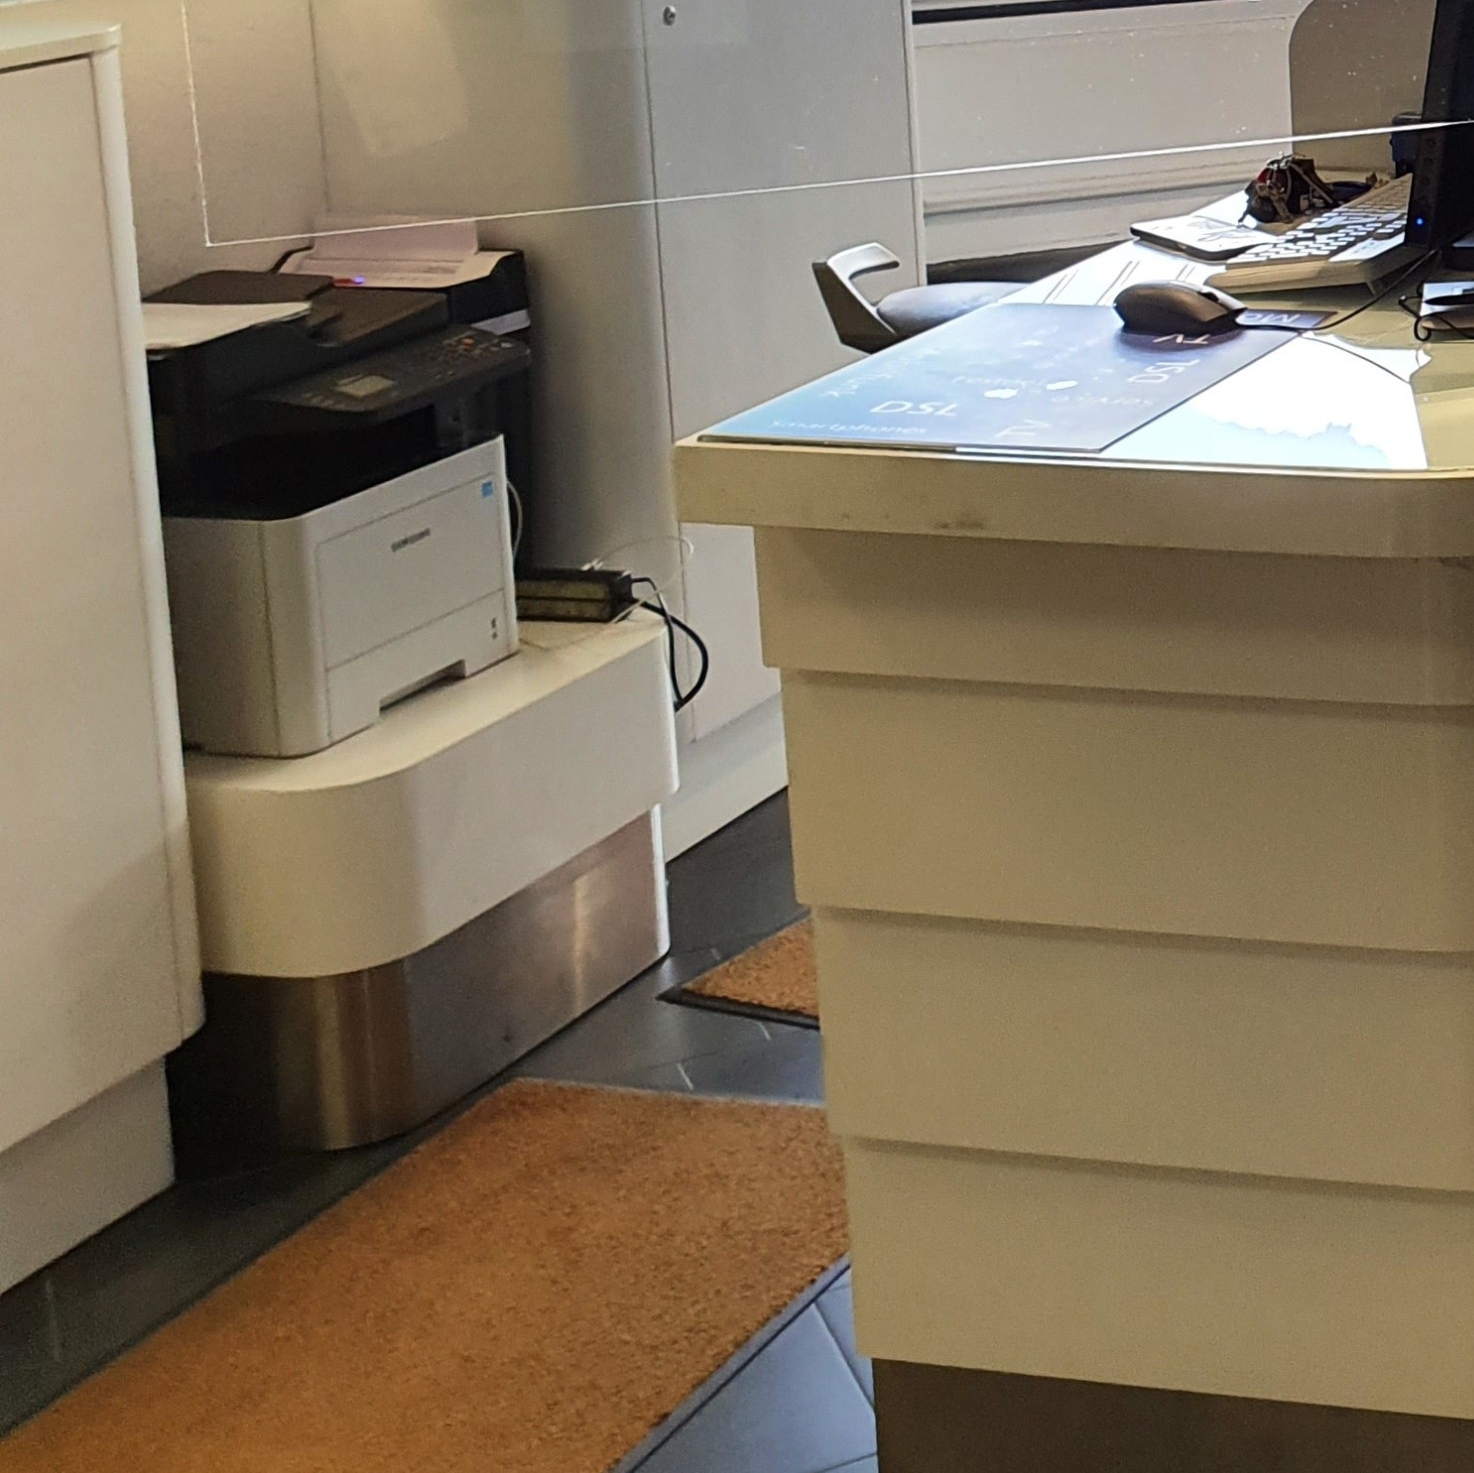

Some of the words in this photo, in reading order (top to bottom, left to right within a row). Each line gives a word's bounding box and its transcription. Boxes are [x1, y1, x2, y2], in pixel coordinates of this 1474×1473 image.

[1125, 359, 1201, 384] DSL
[869, 400, 958, 417] DSL
[995, 418, 1052, 438] TV
